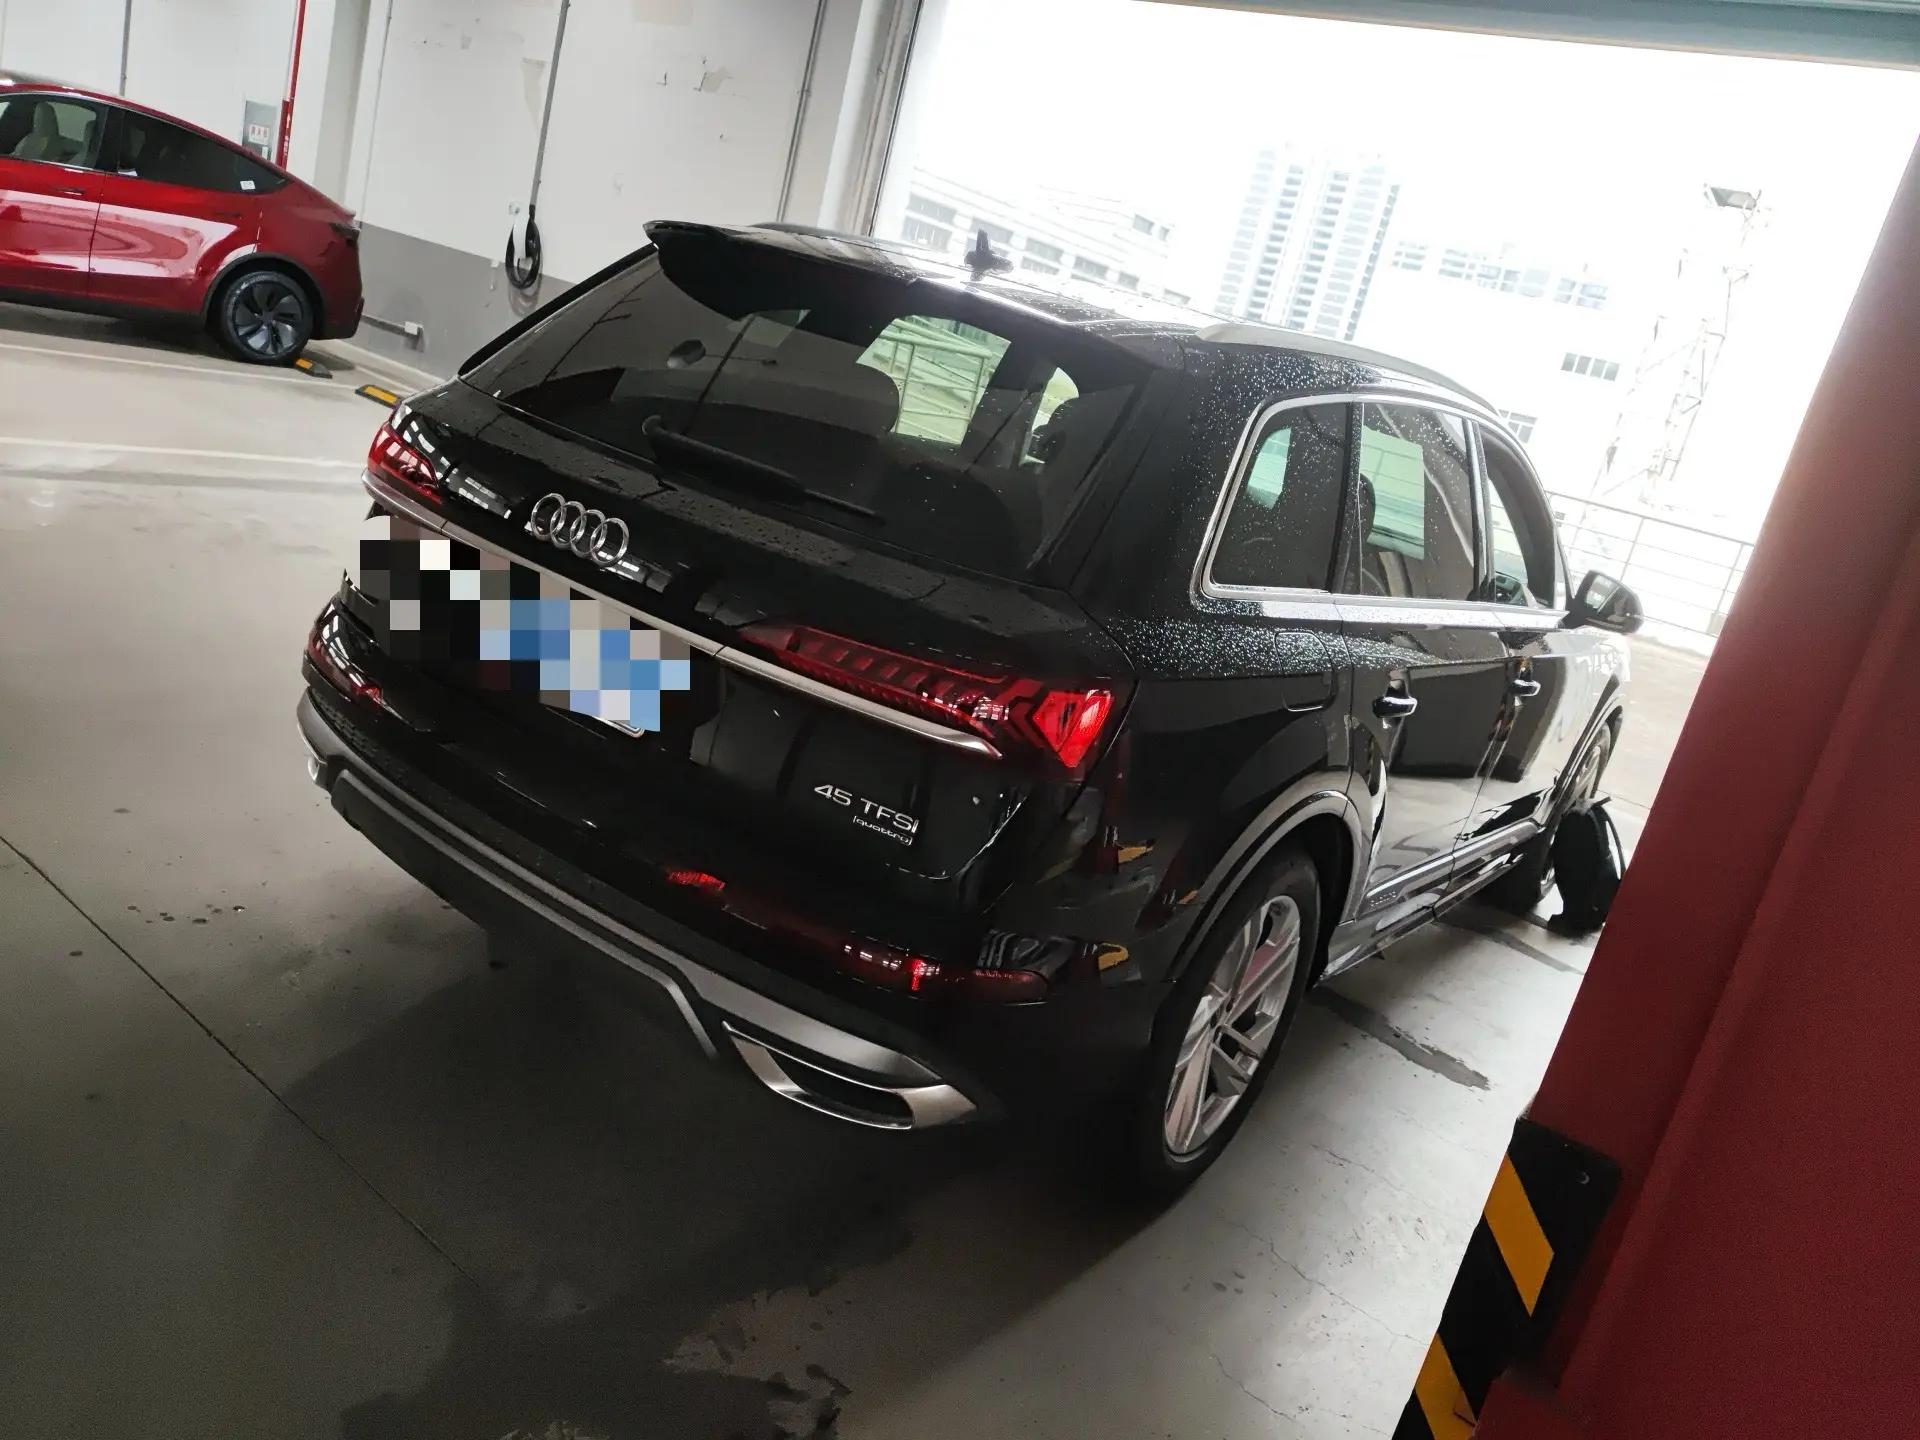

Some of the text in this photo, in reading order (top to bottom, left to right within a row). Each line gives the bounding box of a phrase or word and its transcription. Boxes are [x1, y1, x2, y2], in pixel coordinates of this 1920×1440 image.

[814, 784, 920, 834] 45 TFSI
[855, 817, 911, 845] quattro
